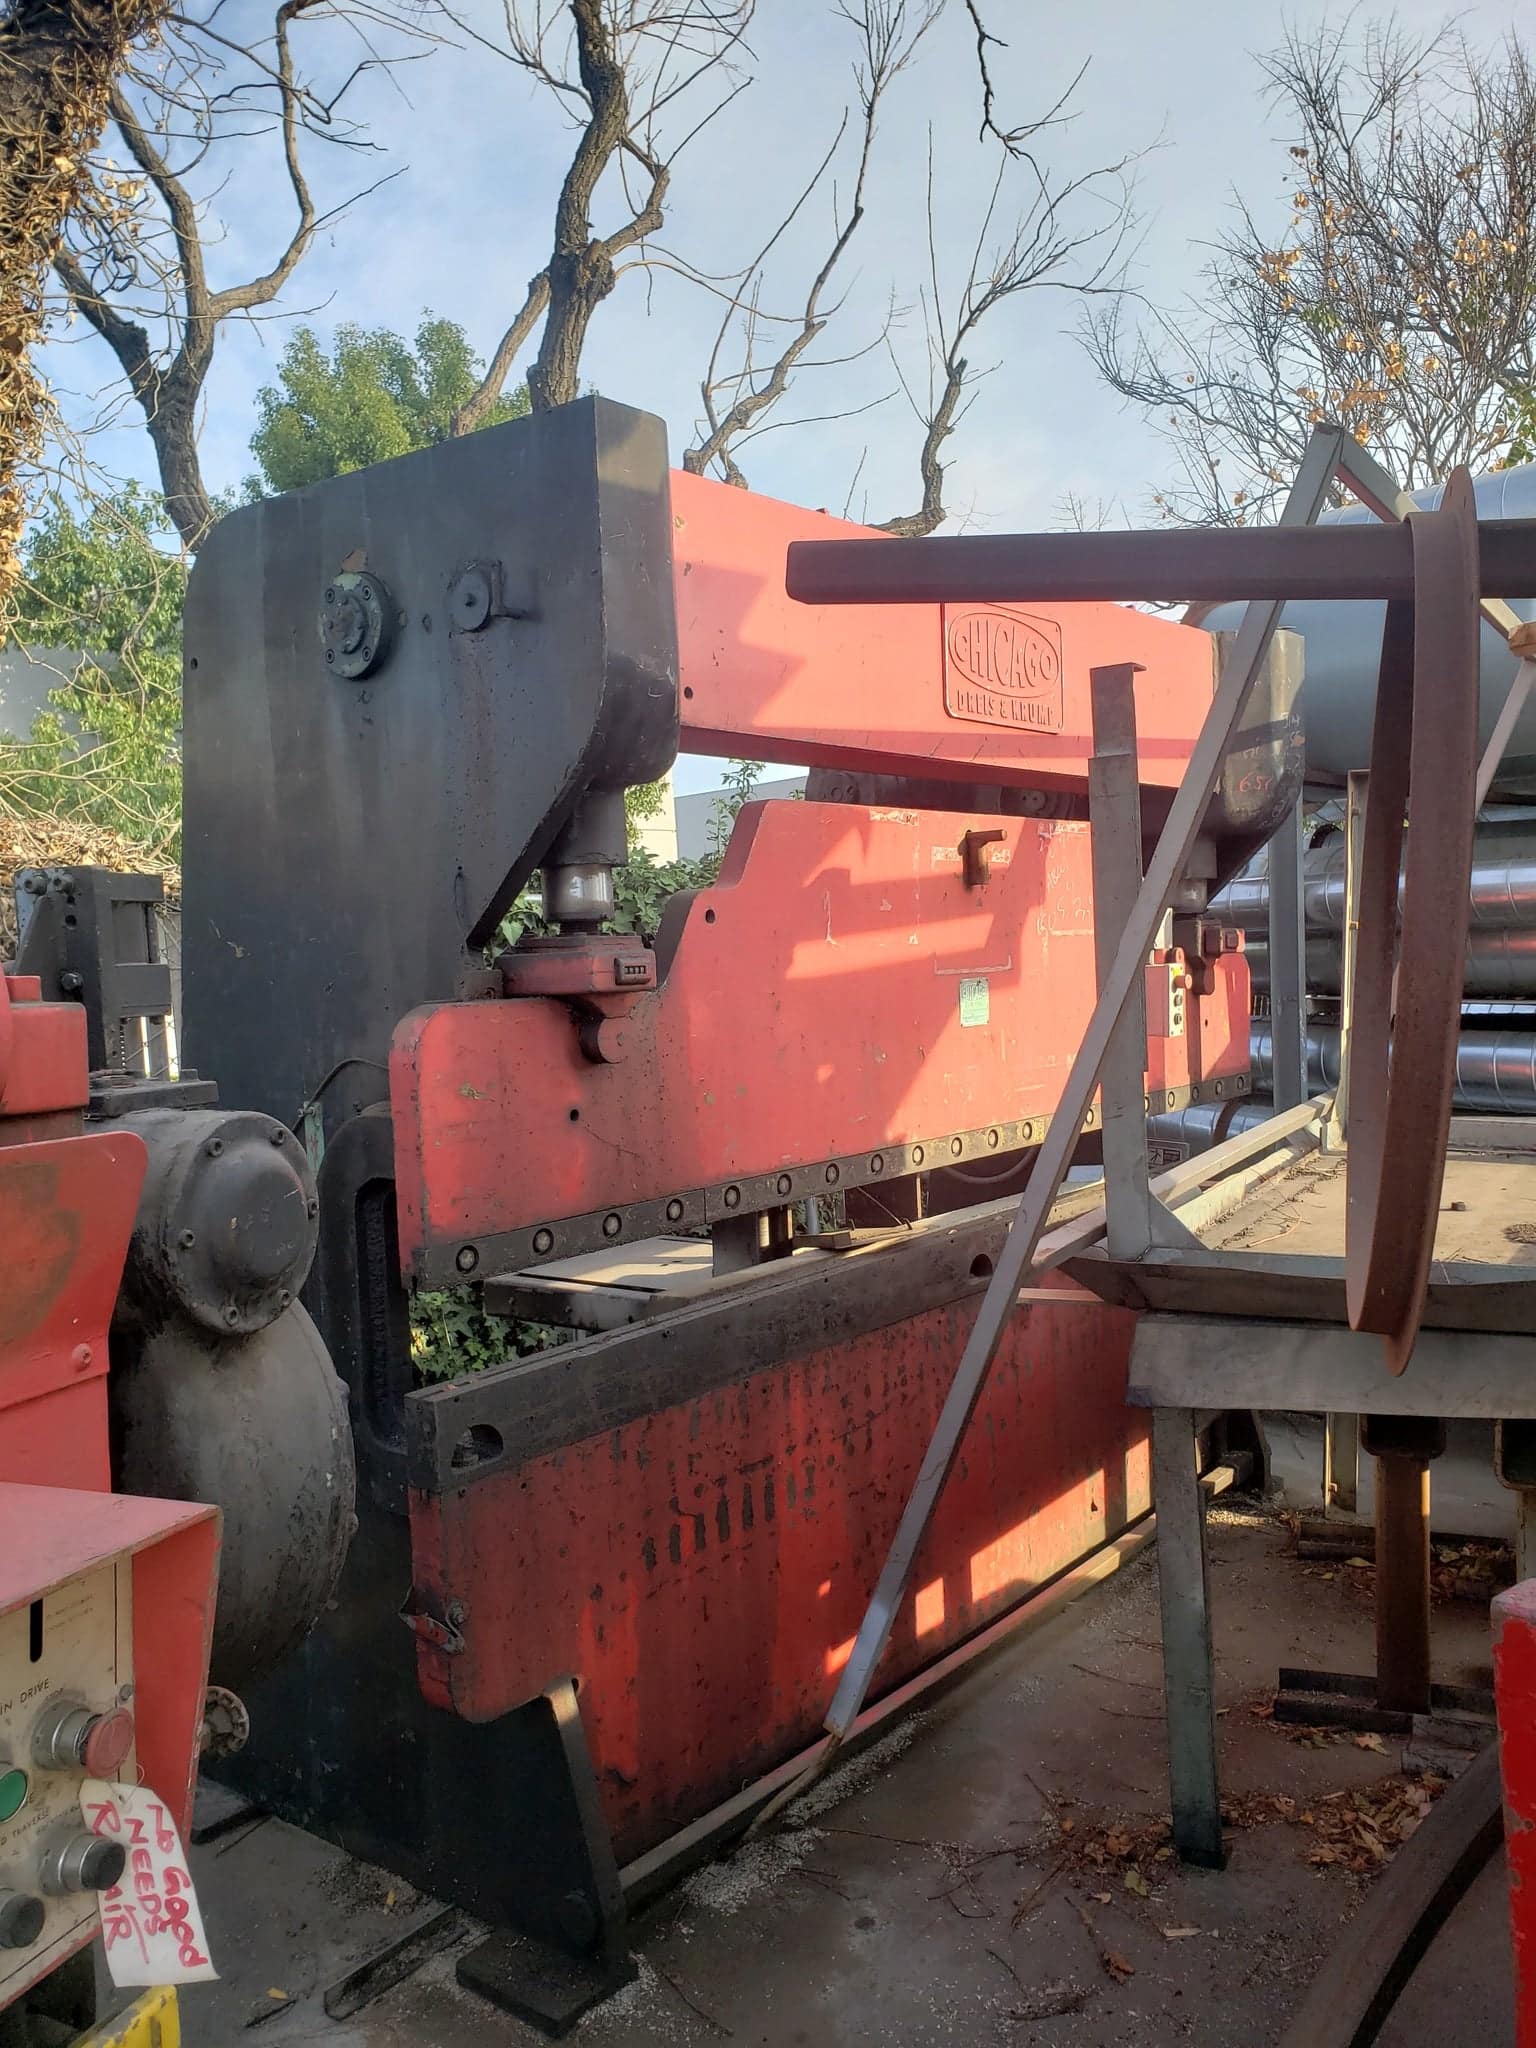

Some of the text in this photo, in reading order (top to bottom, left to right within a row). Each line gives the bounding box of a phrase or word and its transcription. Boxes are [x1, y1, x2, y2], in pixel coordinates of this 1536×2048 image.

[954, 618, 1052, 689] CHICAGO
[957, 689, 994, 717] DREIS
[1011, 698, 1054, 726] KRUMP
[20, 1678, 49, 1704] DRIVE
[145, 1804, 174, 1854] NO
[124, 1818, 165, 1937] NEEDS
